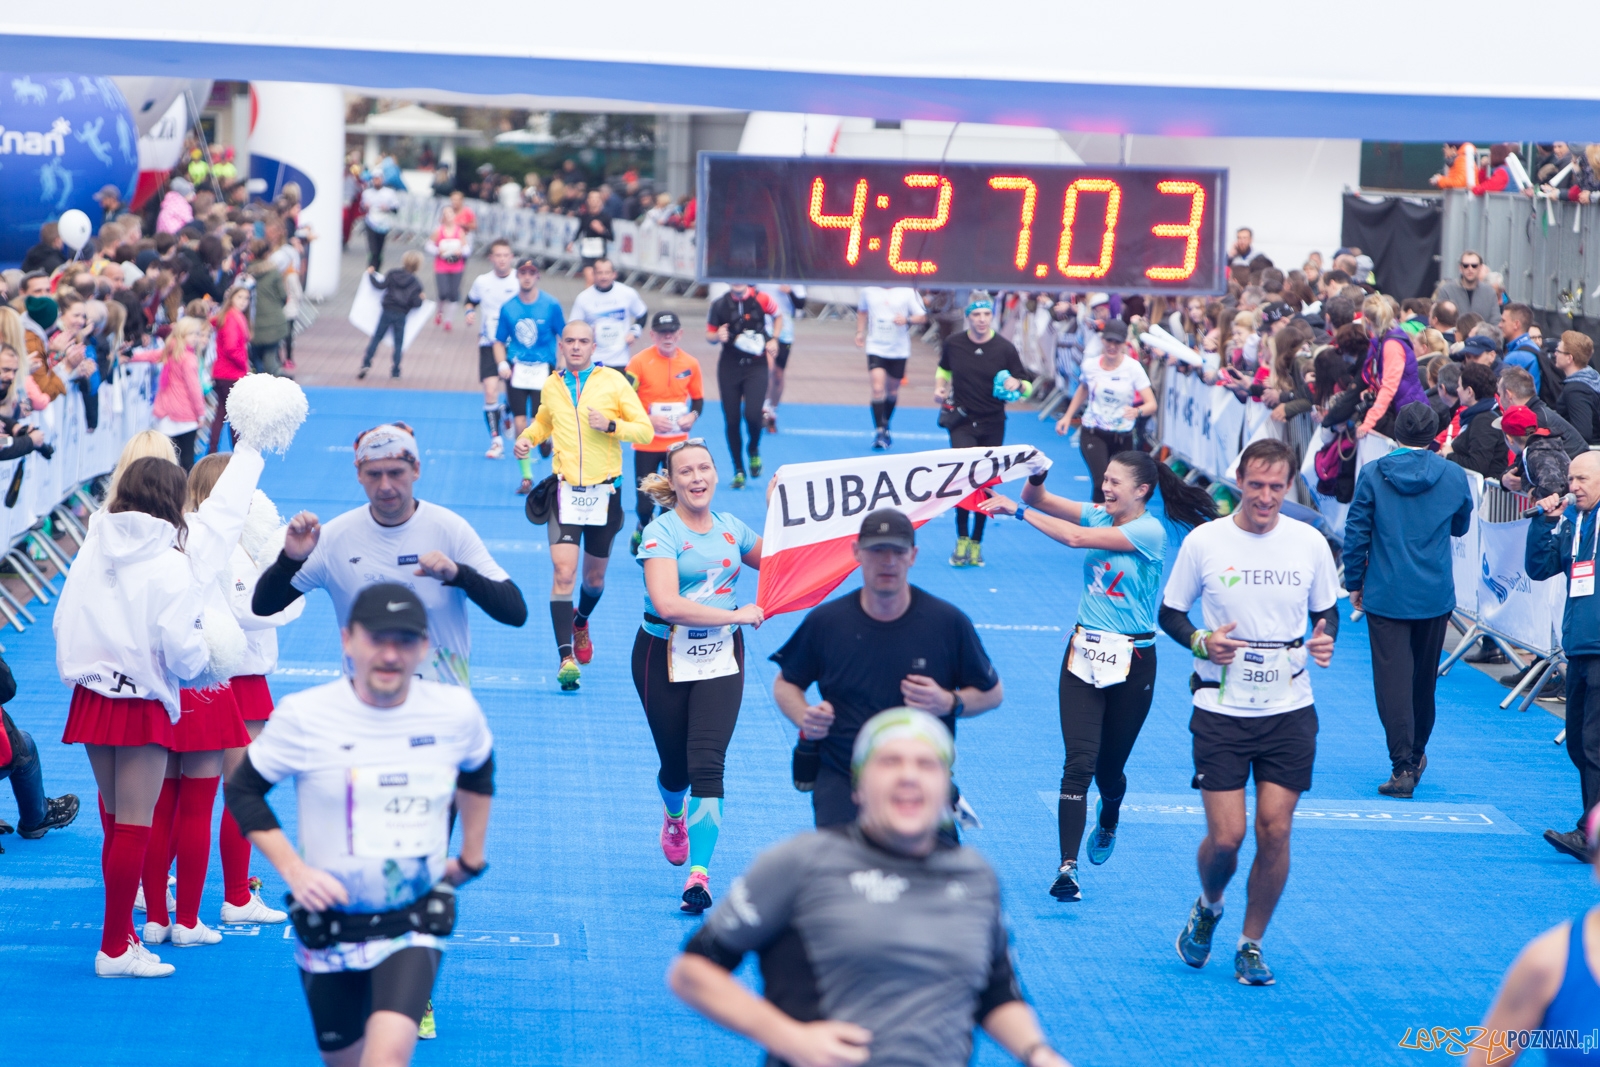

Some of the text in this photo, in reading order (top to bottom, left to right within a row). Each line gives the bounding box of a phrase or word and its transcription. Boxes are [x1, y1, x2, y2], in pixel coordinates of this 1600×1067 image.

[571, 496, 599, 507] 2807
[1241, 569, 1302, 586] TERVIS
[687, 640, 723, 656] 4572
[1243, 668, 1279, 683] 3801
[384, 796, 431, 815] 473
